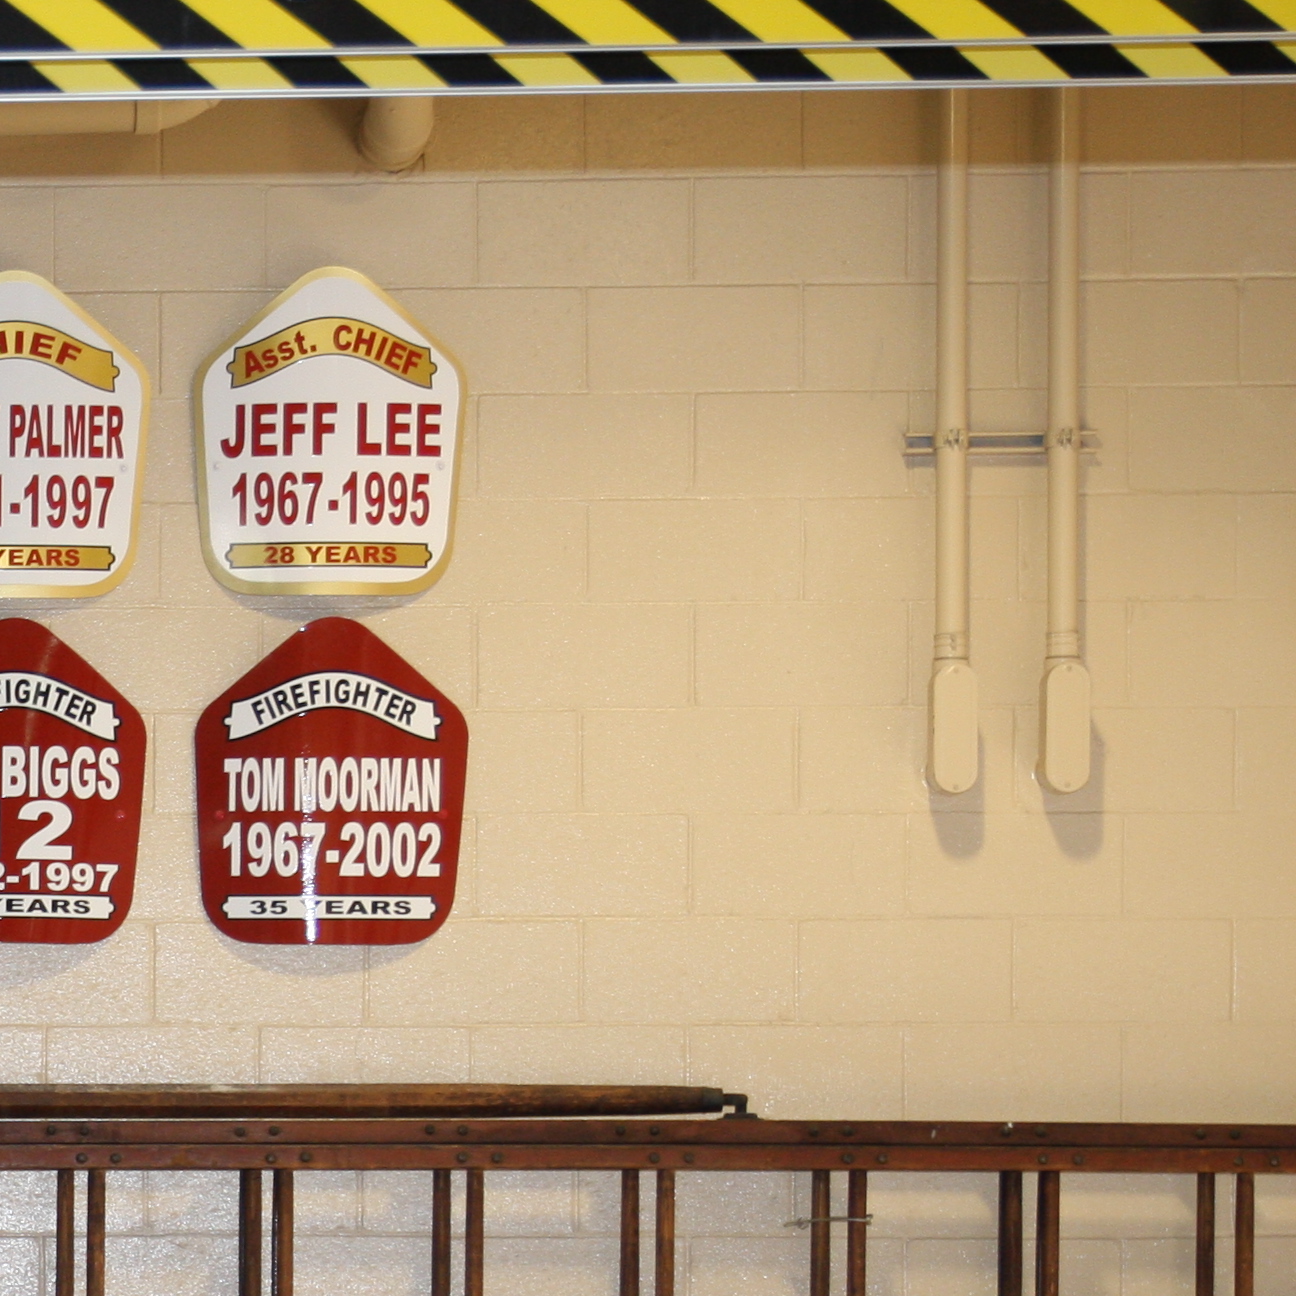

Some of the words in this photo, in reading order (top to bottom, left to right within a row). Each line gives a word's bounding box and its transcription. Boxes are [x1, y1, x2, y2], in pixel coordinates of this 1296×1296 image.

[243, 331, 317, 378] Asst.
[332, 325, 422, 375] CHIEF
[9, 404, 124, 458] PALMER
[220, 402, 338, 458] JEFF
[356, 402, 442, 457] LEE
[232, 471, 430, 527] 1967-1995
[263, 546, 295, 564] 28
[307, 546, 397, 563] YEARS
[250, 678, 417, 726] FIREFIGHTER
[1, 745, 121, 800] BIGGS
[223, 757, 285, 812] TOM
[294, 757, 441, 813] MOORMAN
[222, 821, 441, 878] 1967-2002
[250, 900, 288, 915] 35
